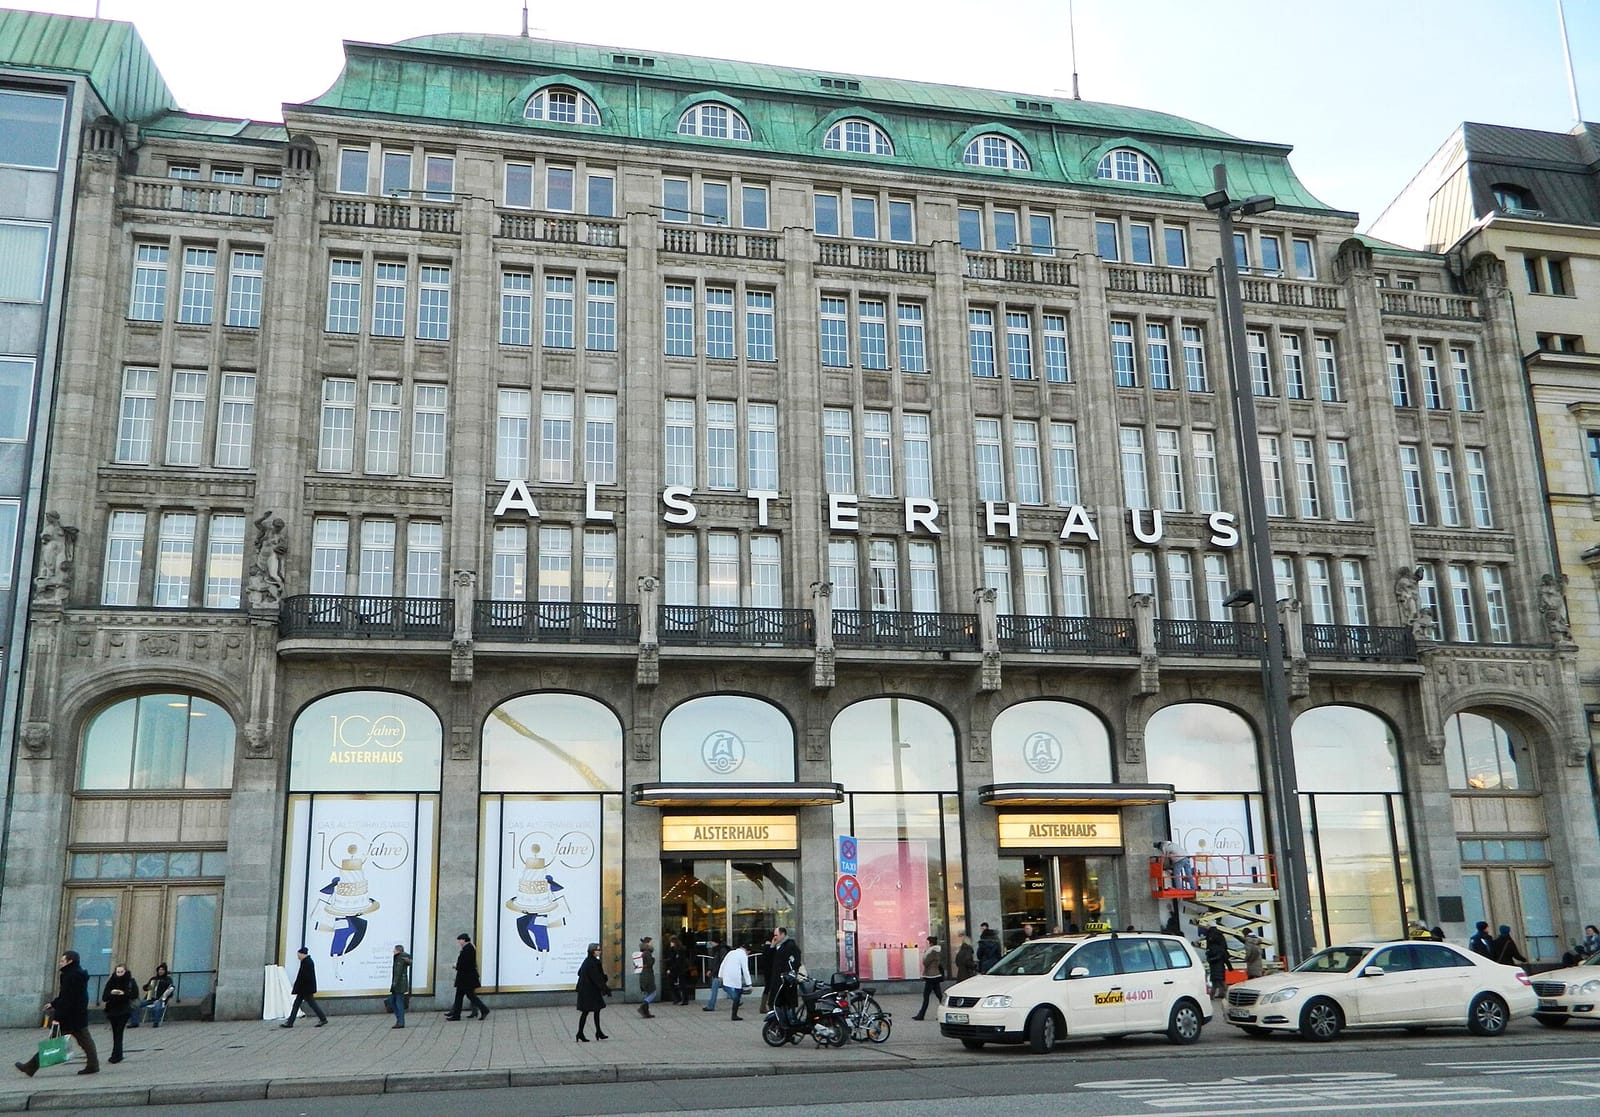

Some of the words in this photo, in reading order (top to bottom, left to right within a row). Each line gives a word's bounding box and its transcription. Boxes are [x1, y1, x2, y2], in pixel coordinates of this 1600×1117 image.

[493, 479, 1240, 548] ALSTERHAUS
[330, 714, 406, 748] 100
[367, 724, 401, 736] Jahre
[329, 751, 404, 763] ALSTERHAUS
[693, 826, 769, 840] ALSTERHAUS
[1029, 824, 1097, 837] ALSTERHAUS
[317, 831, 409, 870] 100
[363, 842, 402, 856] Jahre
[508, 831, 595, 869] 100
[552, 842, 589, 855] Jahre
[841, 861, 857, 871] TAXI
[1094, 991, 1124, 1005] Taxiruf
[1126, 990, 1153, 1001] 441011
